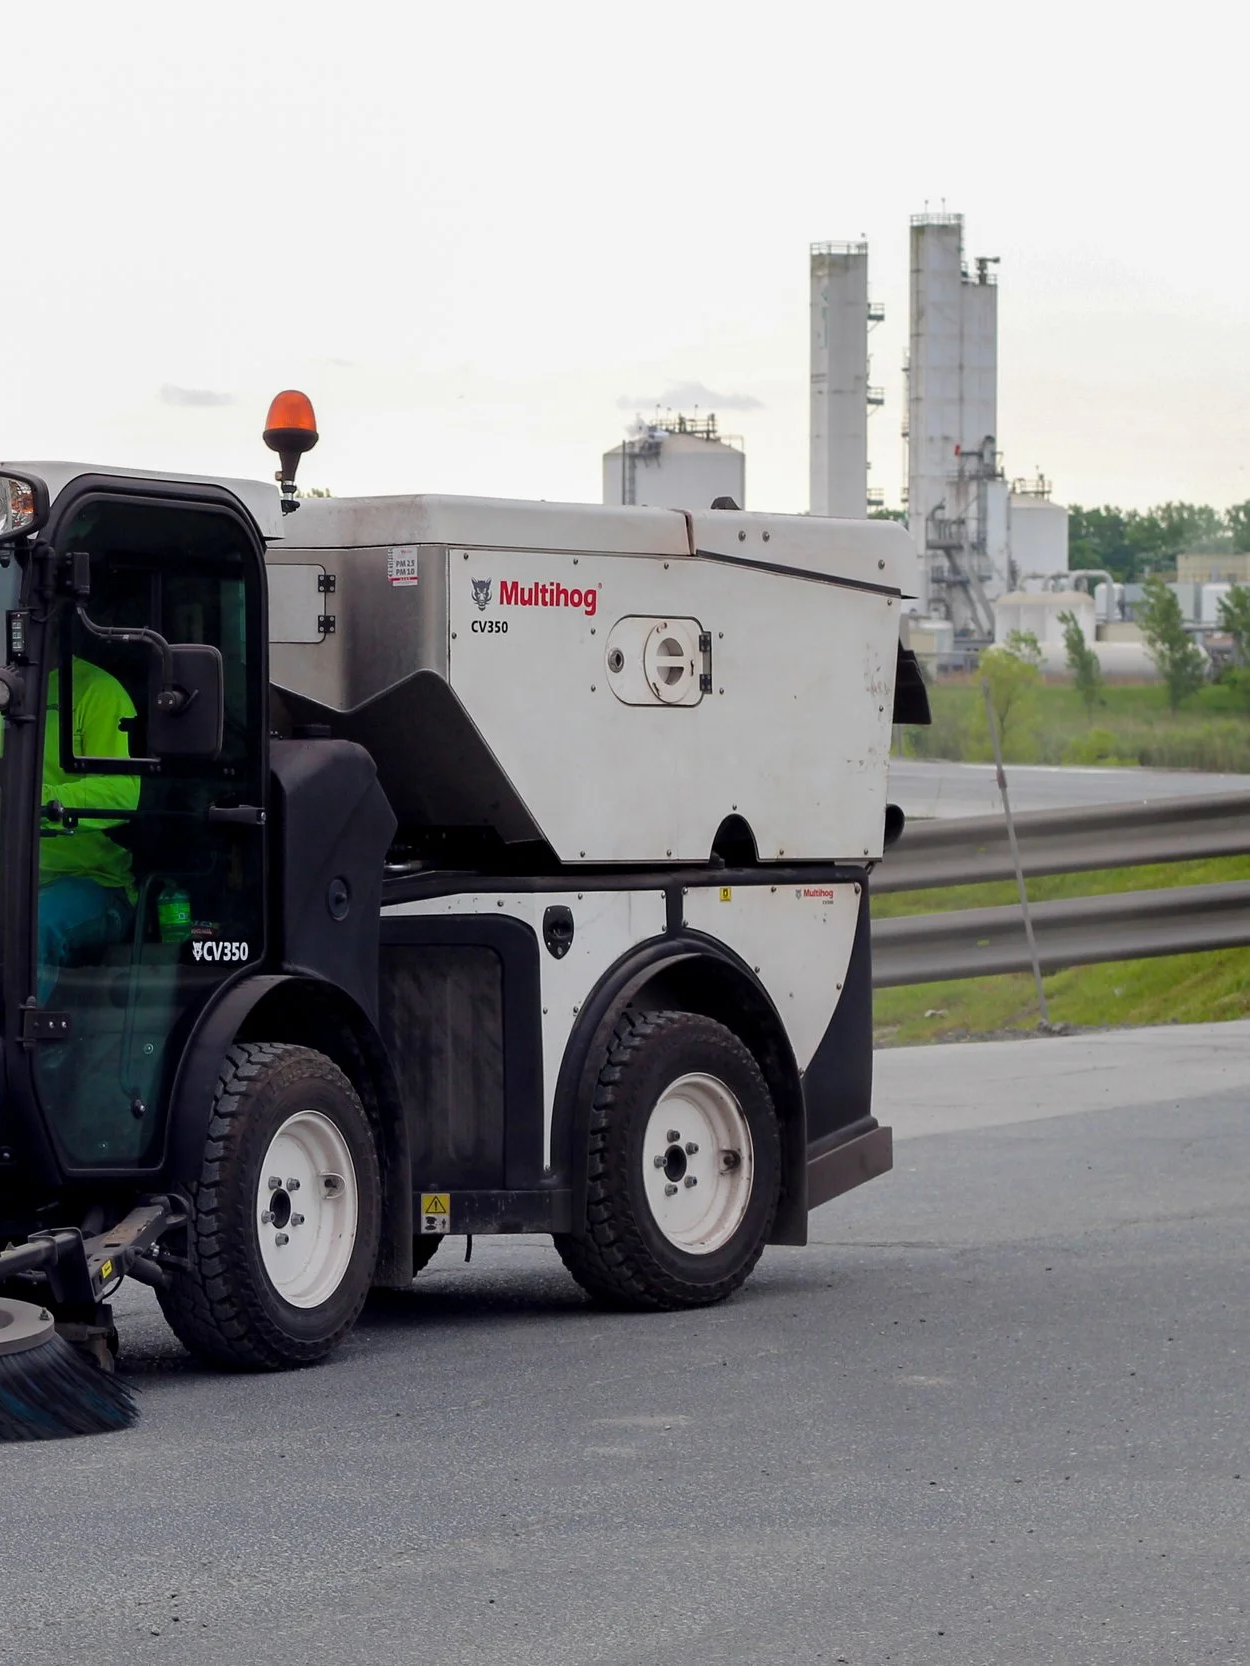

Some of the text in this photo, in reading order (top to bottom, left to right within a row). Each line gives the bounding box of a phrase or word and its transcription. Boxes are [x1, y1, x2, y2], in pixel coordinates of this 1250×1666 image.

[499, 580, 597, 616] Multihog
[471, 620, 509, 634] CV350
[804, 889, 834, 899] Multihog
[203, 942, 249, 961] CV350
